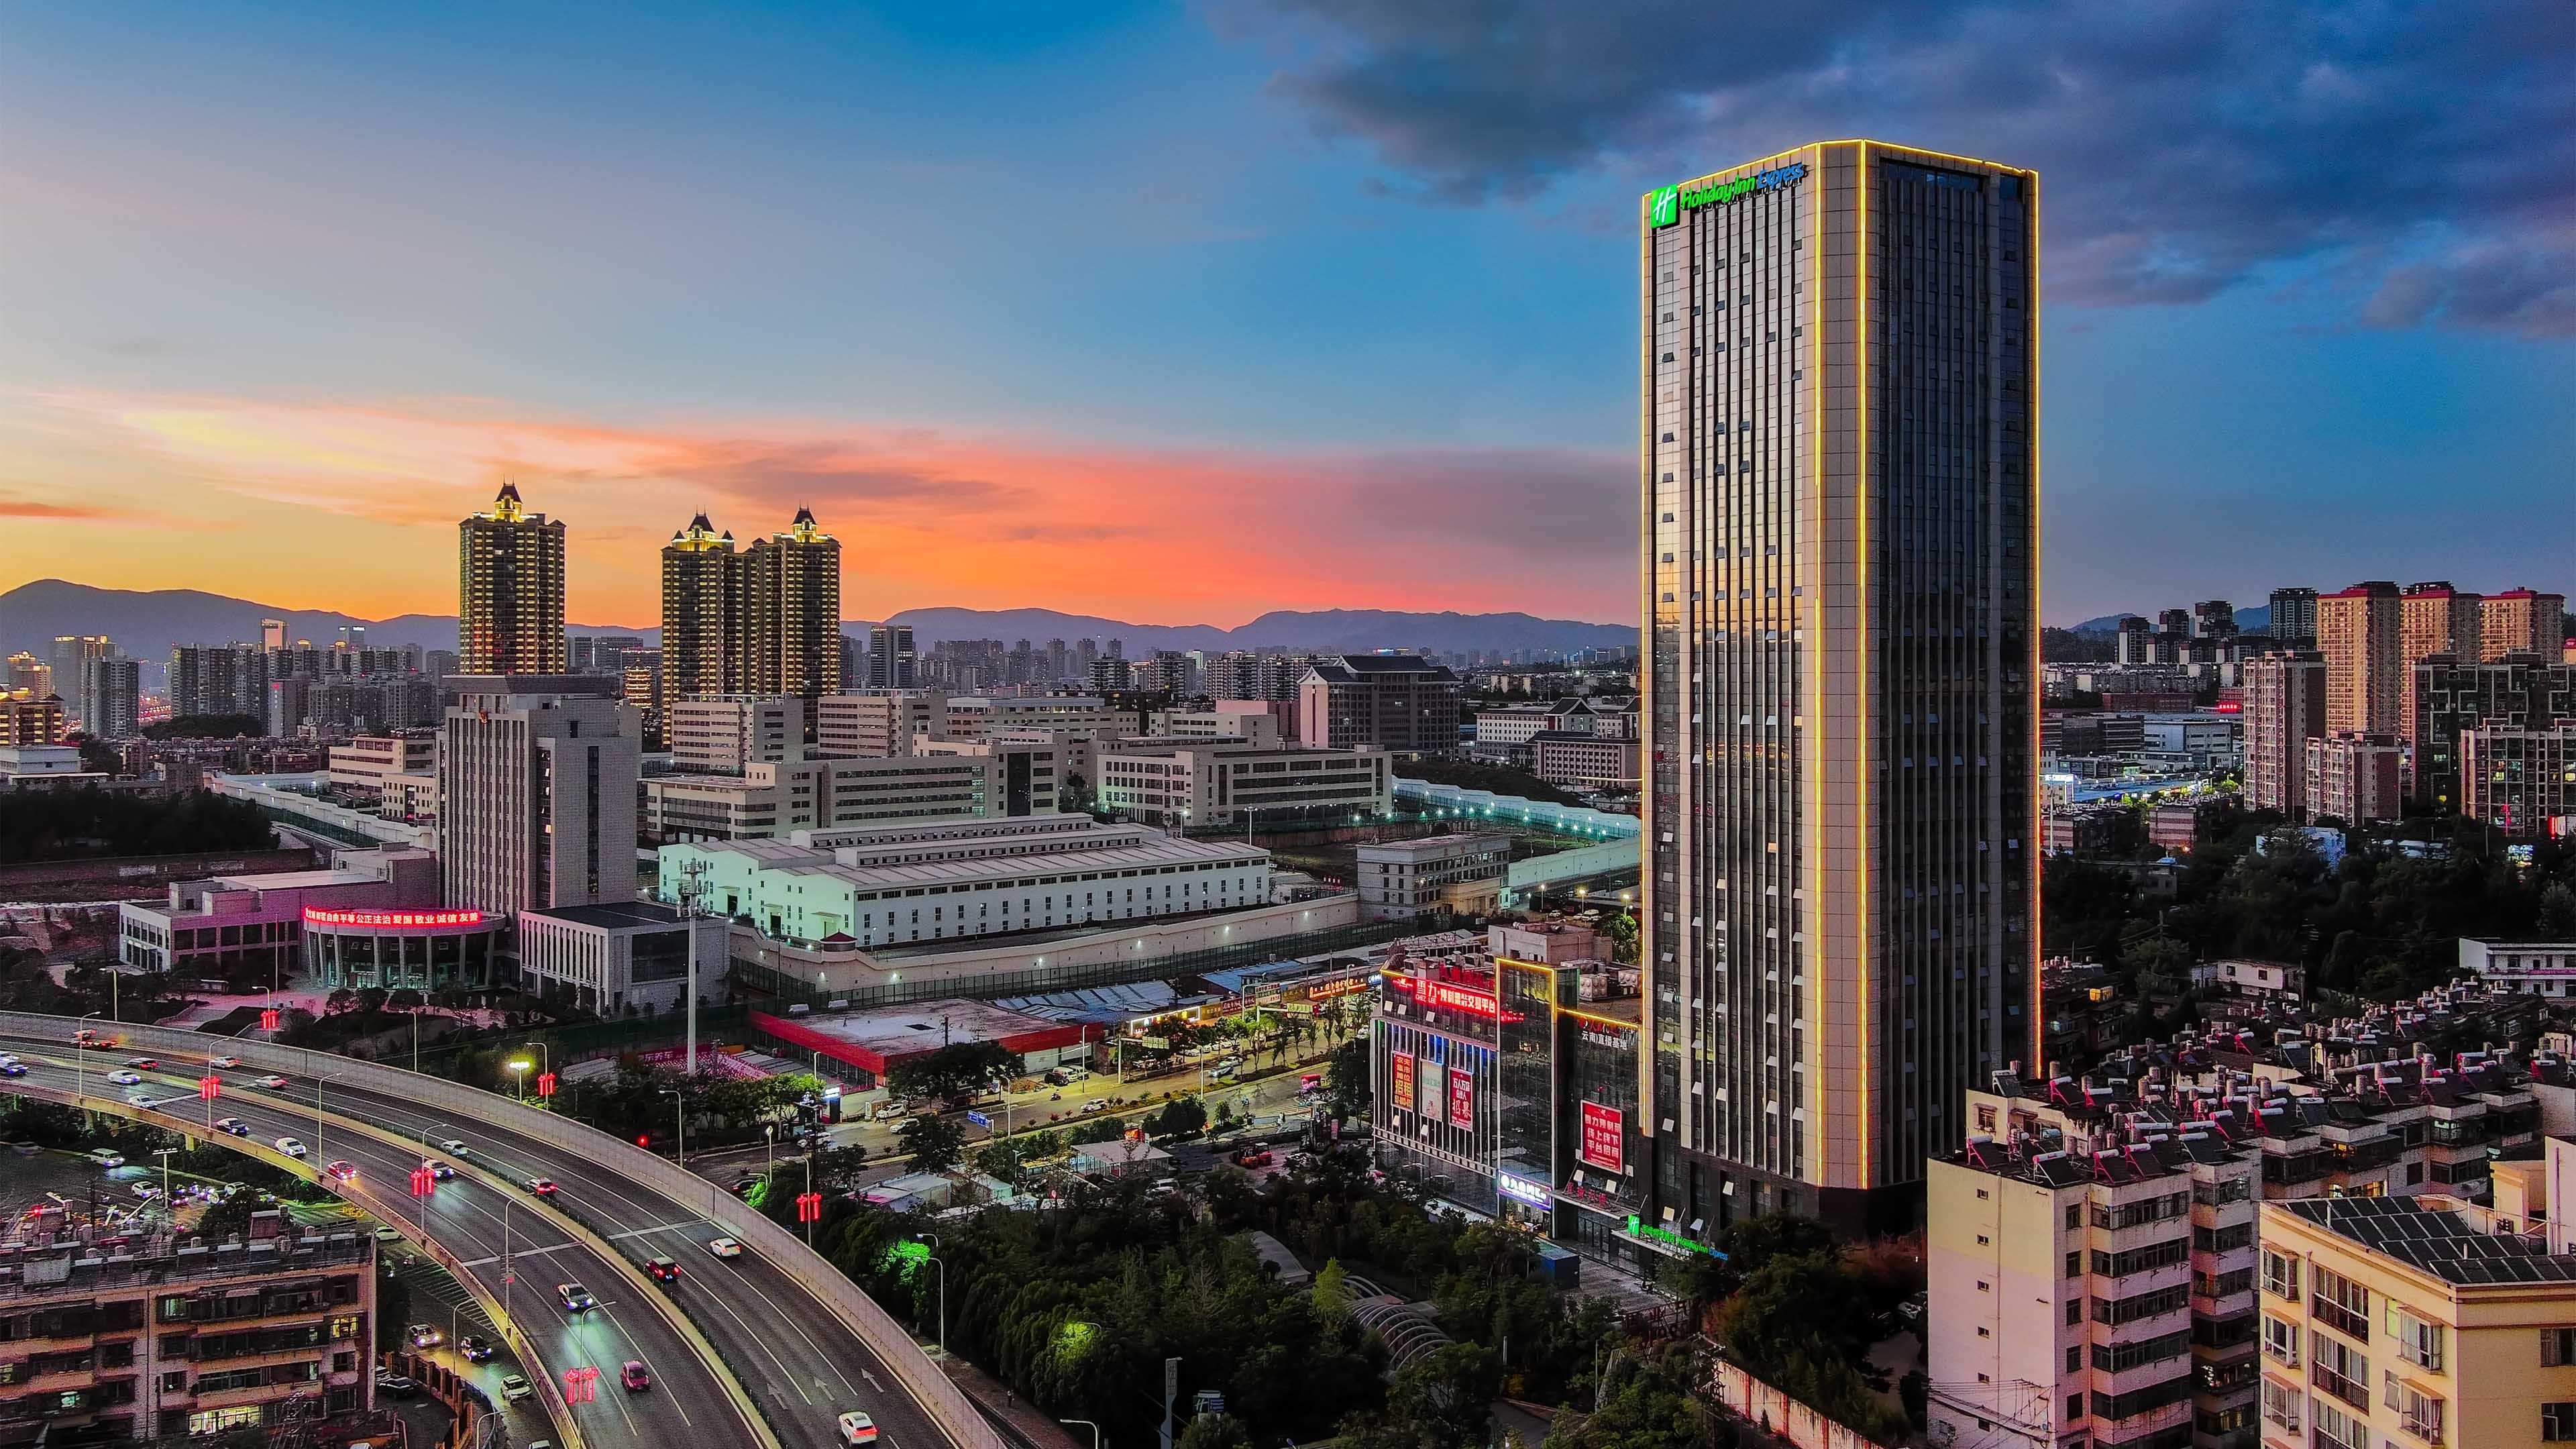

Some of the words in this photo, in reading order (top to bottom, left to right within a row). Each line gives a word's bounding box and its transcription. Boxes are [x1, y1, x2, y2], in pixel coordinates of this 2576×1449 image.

[1681, 184, 1733, 210] Holiday
[1735, 176, 1755, 194] Inn
[1758, 164, 1803, 189] Express
[393, 915, 413, 924] 爱国
[415, 915, 435, 924] 敬业
[437, 914, 457, 924] 诚信
[460, 912, 478, 922] 友善
[1415, 994, 1426, 1002] CHEZ
[1395, 1078, 1412, 1097] 招租
[1678, 1236, 1699, 1252] Holiday
[1709, 1246, 1729, 1261] Express
